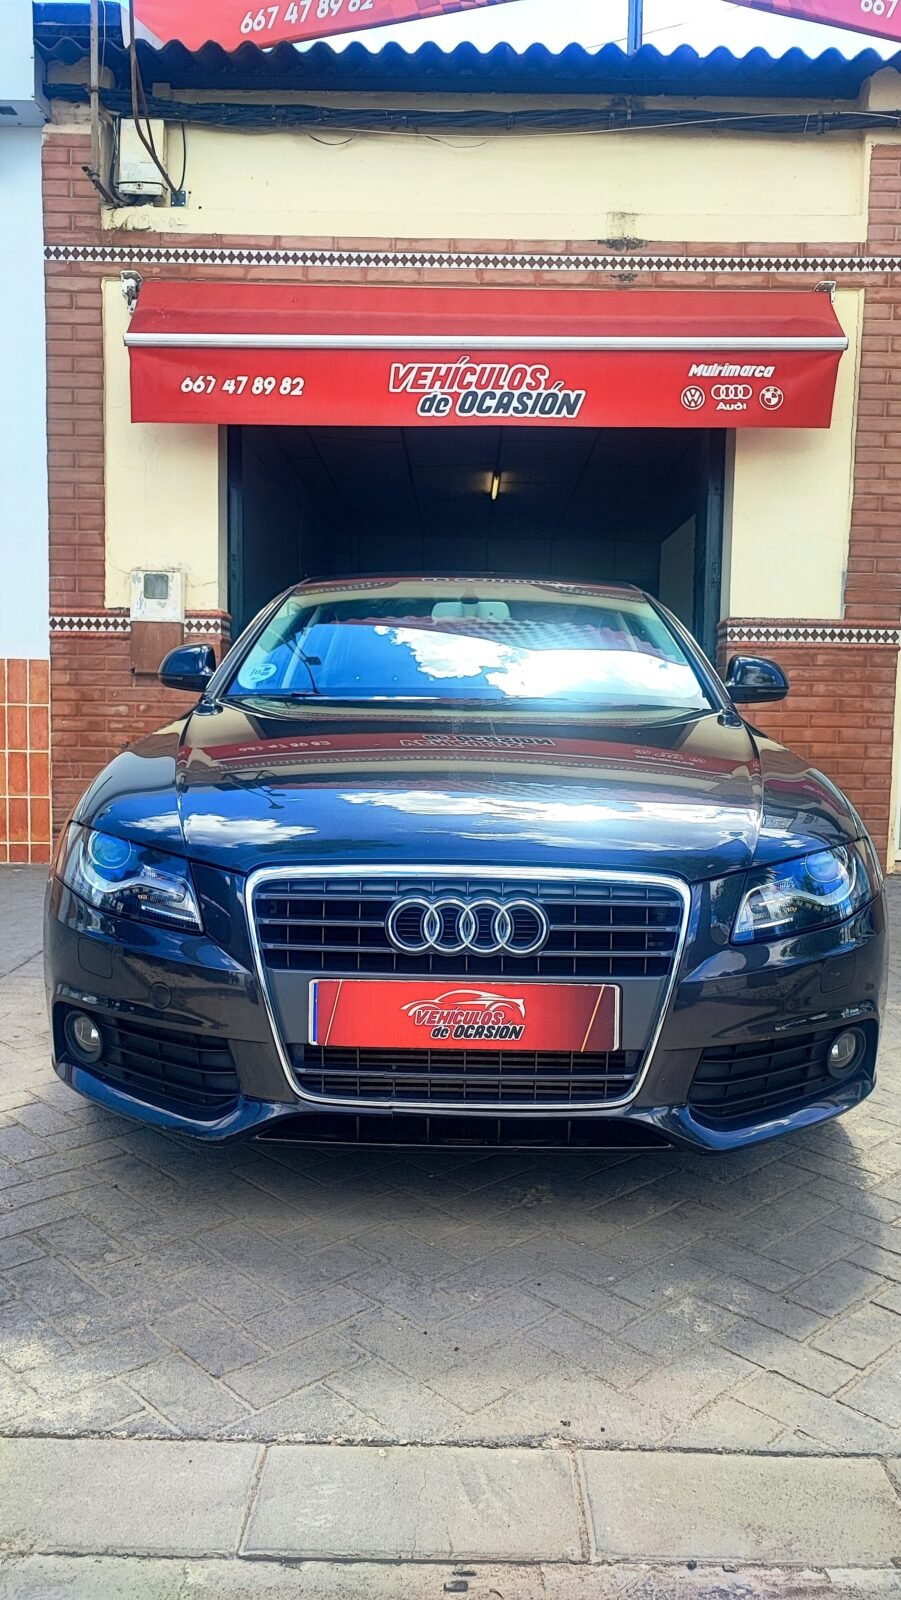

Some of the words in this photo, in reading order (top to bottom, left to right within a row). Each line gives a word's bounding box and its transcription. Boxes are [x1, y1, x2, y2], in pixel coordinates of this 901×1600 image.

[240, 5, 280, 34] 667
[283, 0, 311, 24] 47
[316, 0, 343, 19] 89
[388, 354, 549, 393] VEHÍCULOS
[180, 375, 217, 394] 667
[222, 376, 249, 395] 47
[251, 376, 277, 395] 89
[279, 376, 305, 396] 82
[416, 391, 453, 417] de
[455, 380, 587, 418] OCASIÓN
[715, 401, 747, 411] Audi
[414, 1006, 505, 1026] VEHÍCULOS
[430, 1024, 451, 1039] de
[452, 1020, 525, 1041] OCASIÓN
